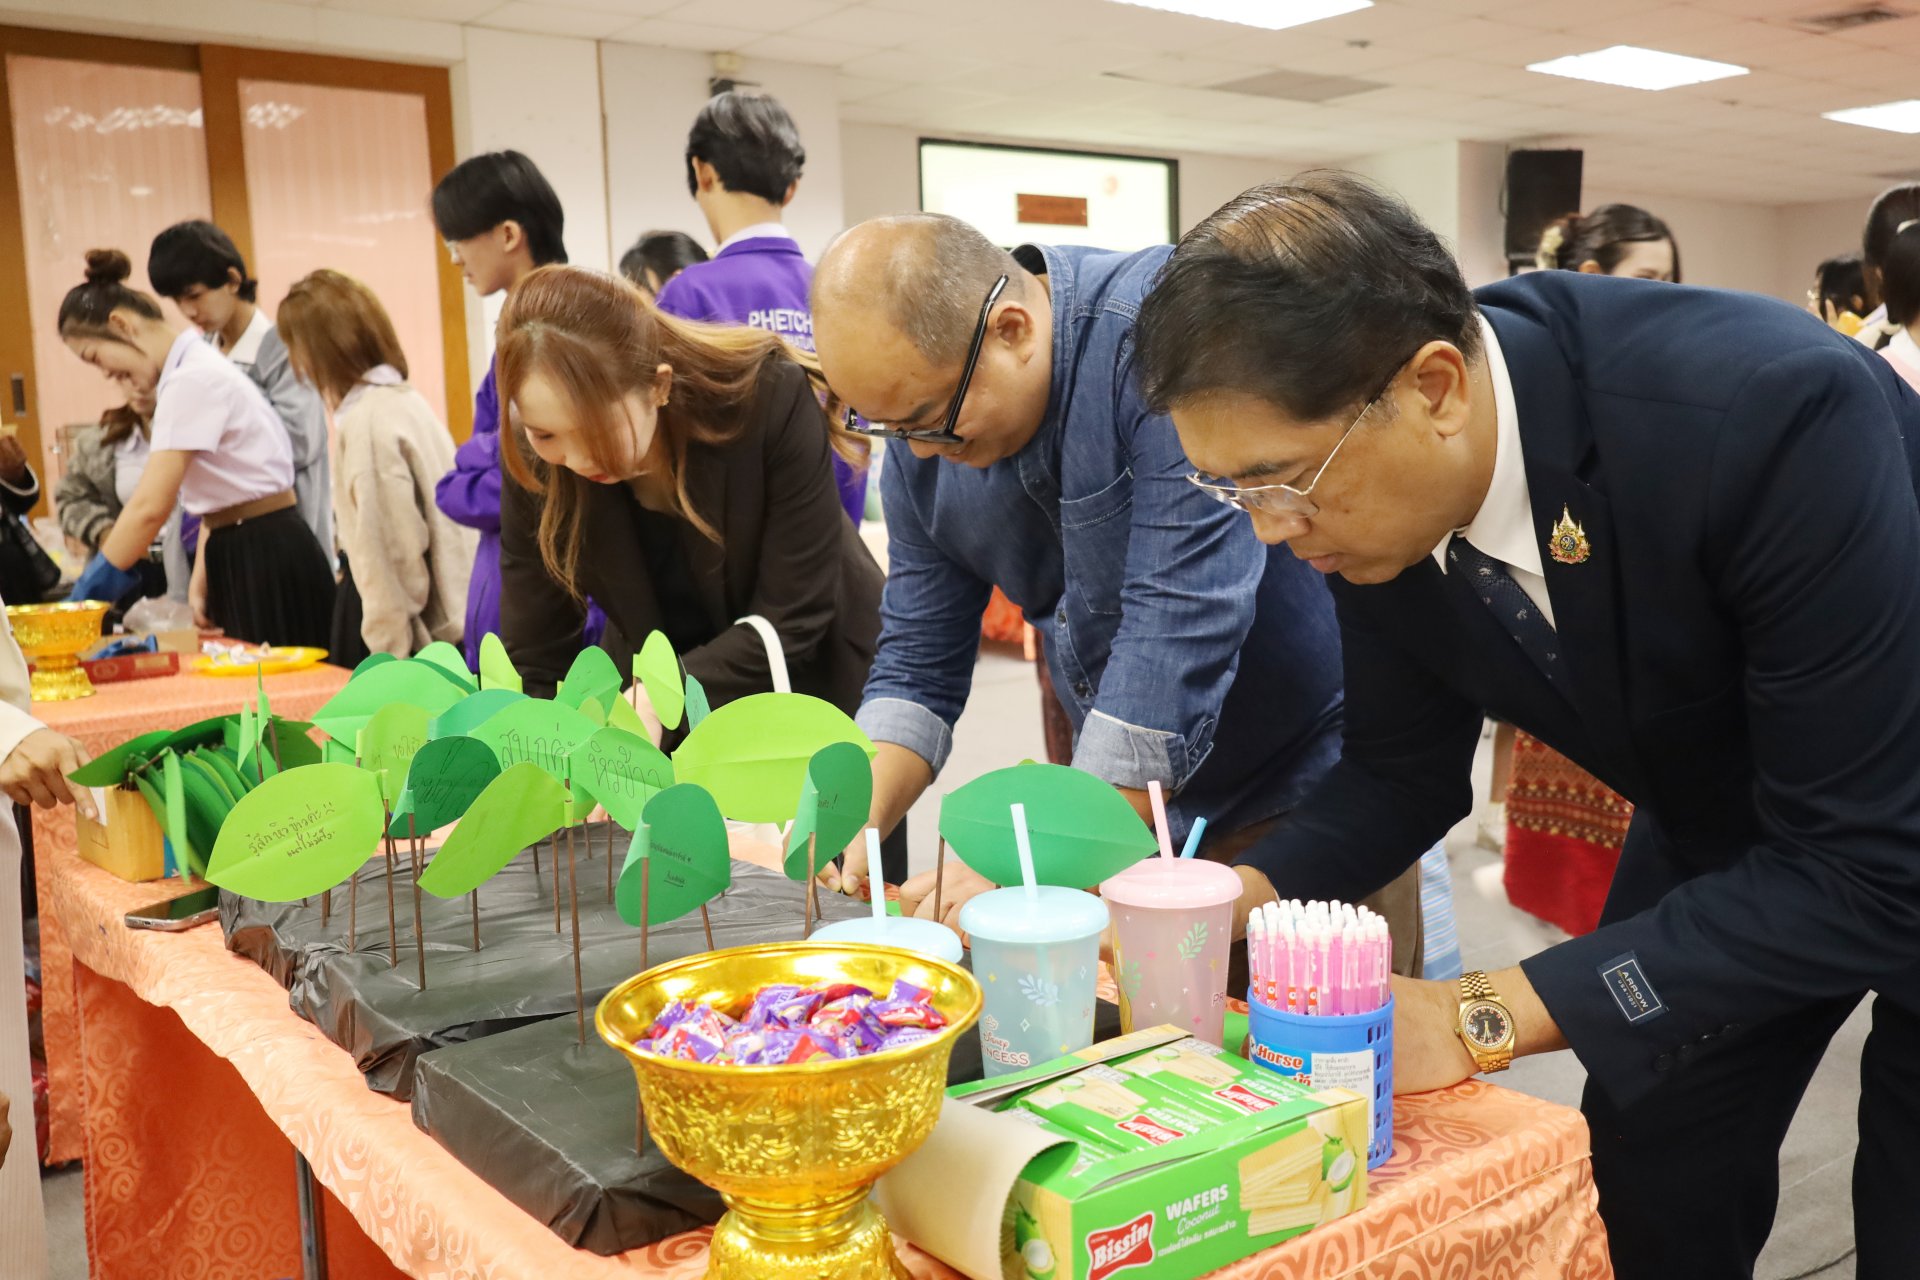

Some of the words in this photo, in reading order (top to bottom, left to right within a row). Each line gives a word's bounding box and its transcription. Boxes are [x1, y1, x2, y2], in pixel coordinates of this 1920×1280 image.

[1622, 971, 1648, 1008] ARROW
[981, 1045, 1029, 1066] INCESS
[1257, 1045, 1304, 1069] Horse
[1166, 1184, 1228, 1221] WAFERS
[1177, 1204, 1220, 1236] Coconut
[1093, 1223, 1149, 1271] Bissin
